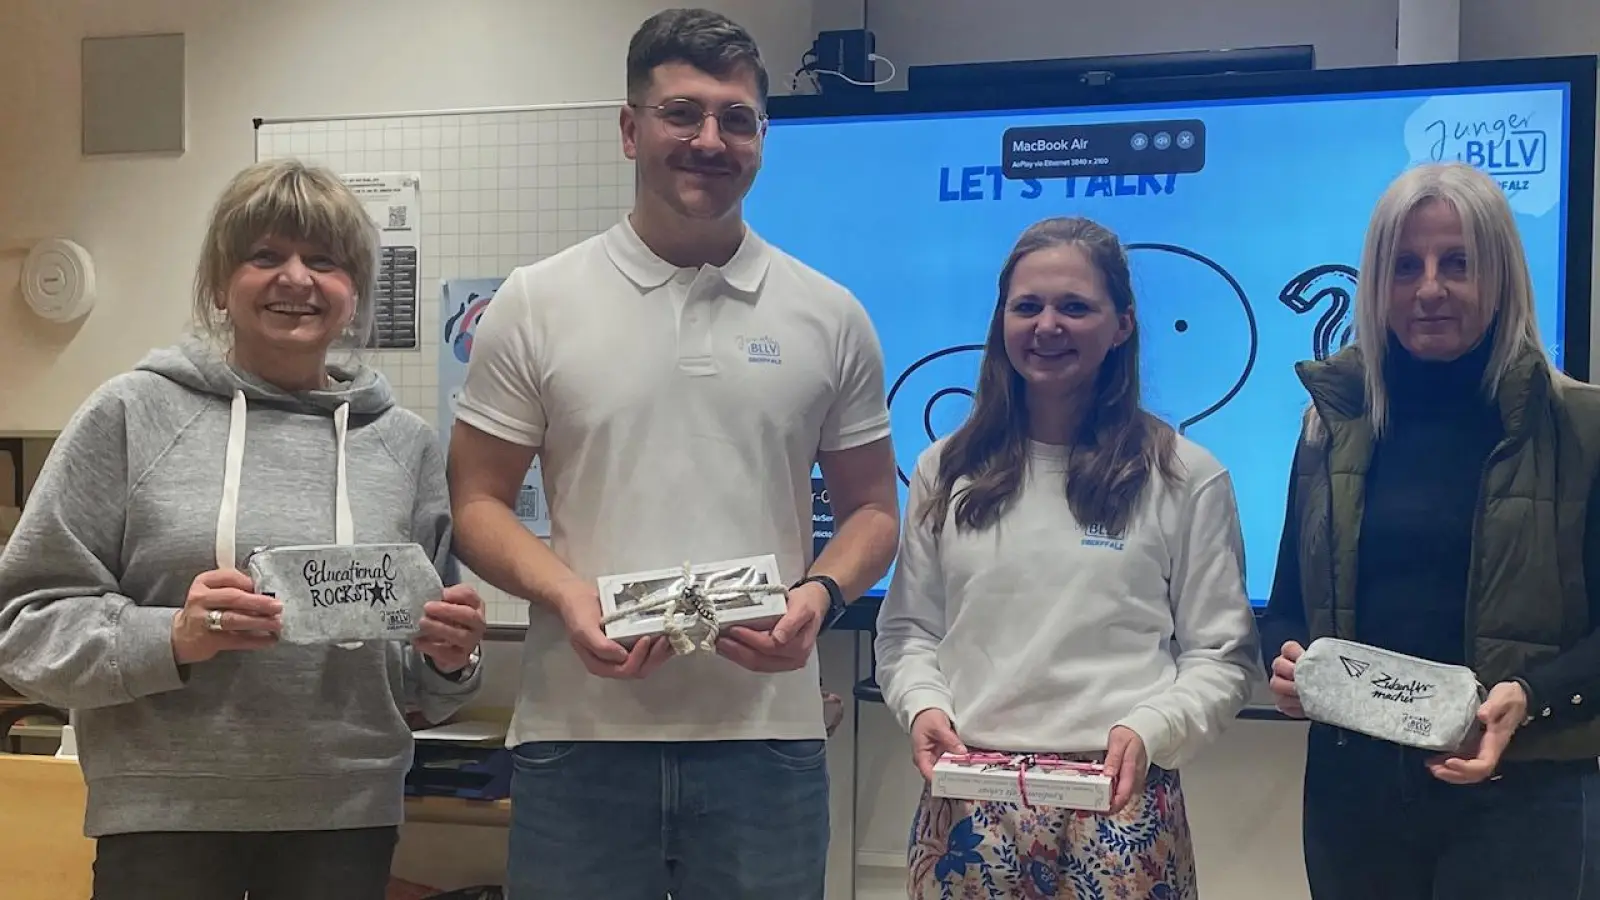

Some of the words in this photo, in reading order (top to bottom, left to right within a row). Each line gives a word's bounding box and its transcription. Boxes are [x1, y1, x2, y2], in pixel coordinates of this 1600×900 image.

[1012, 139, 1068, 152] MacBook
[1070, 138, 1089, 150] Air
[1425, 111, 1535, 161] Junger
[1467, 137, 1539, 168] BLLV
[939, 165, 1043, 202] LETS
[303, 553, 397, 587] Educational
